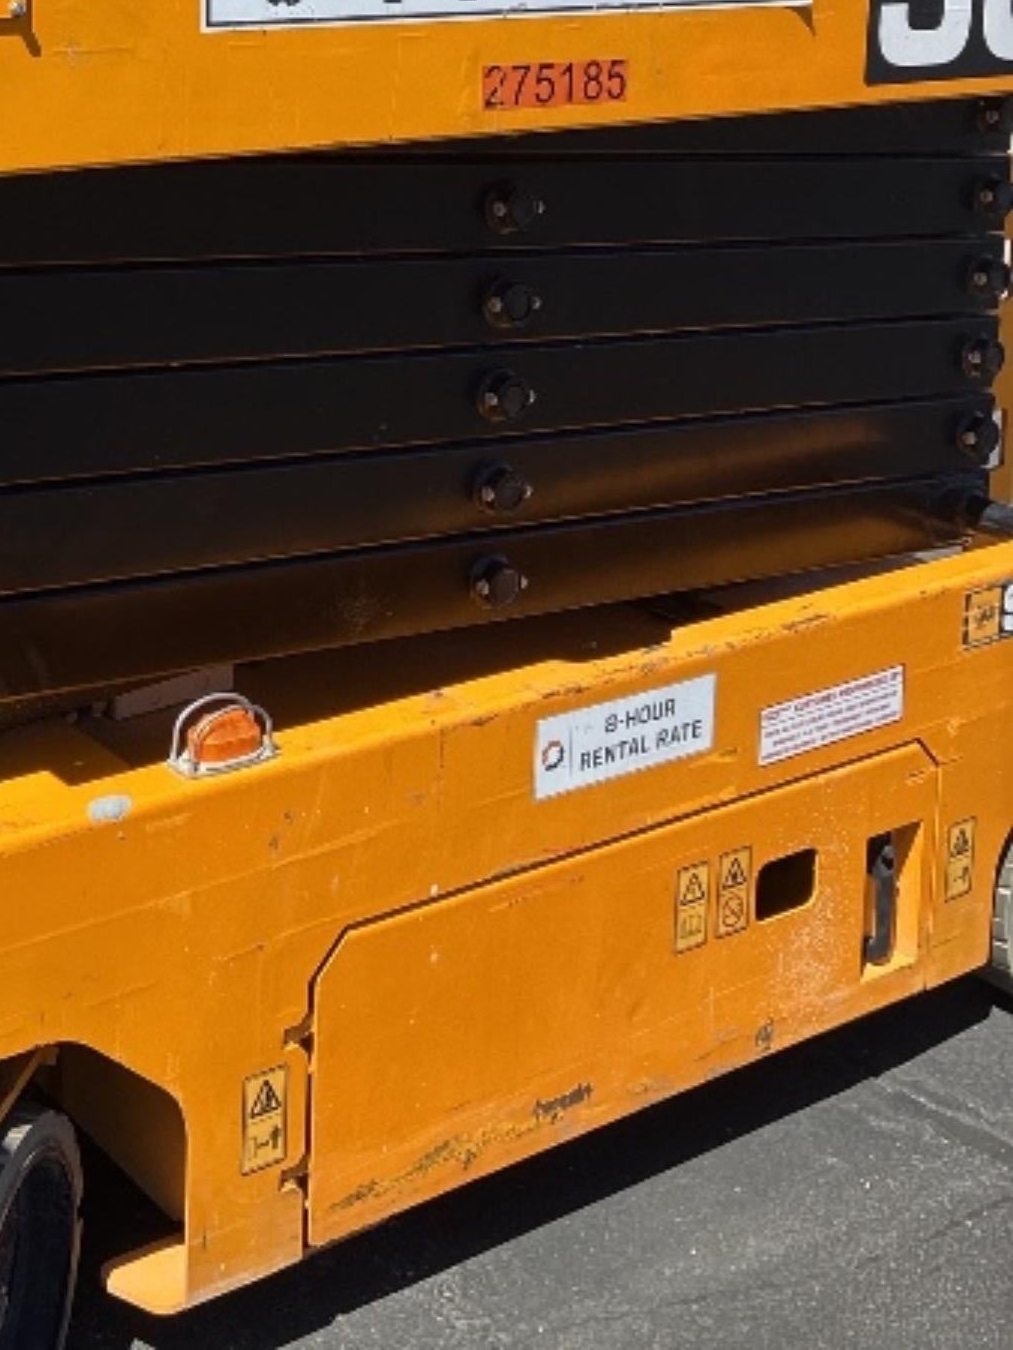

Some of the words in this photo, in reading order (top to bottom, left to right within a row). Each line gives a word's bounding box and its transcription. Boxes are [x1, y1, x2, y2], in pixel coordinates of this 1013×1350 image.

[484, 59, 628, 109] 275185
[604, 698, 677, 734] 8-HOUR
[580, 734, 651, 772] RENTAL
[656, 719, 703, 750] RATE
